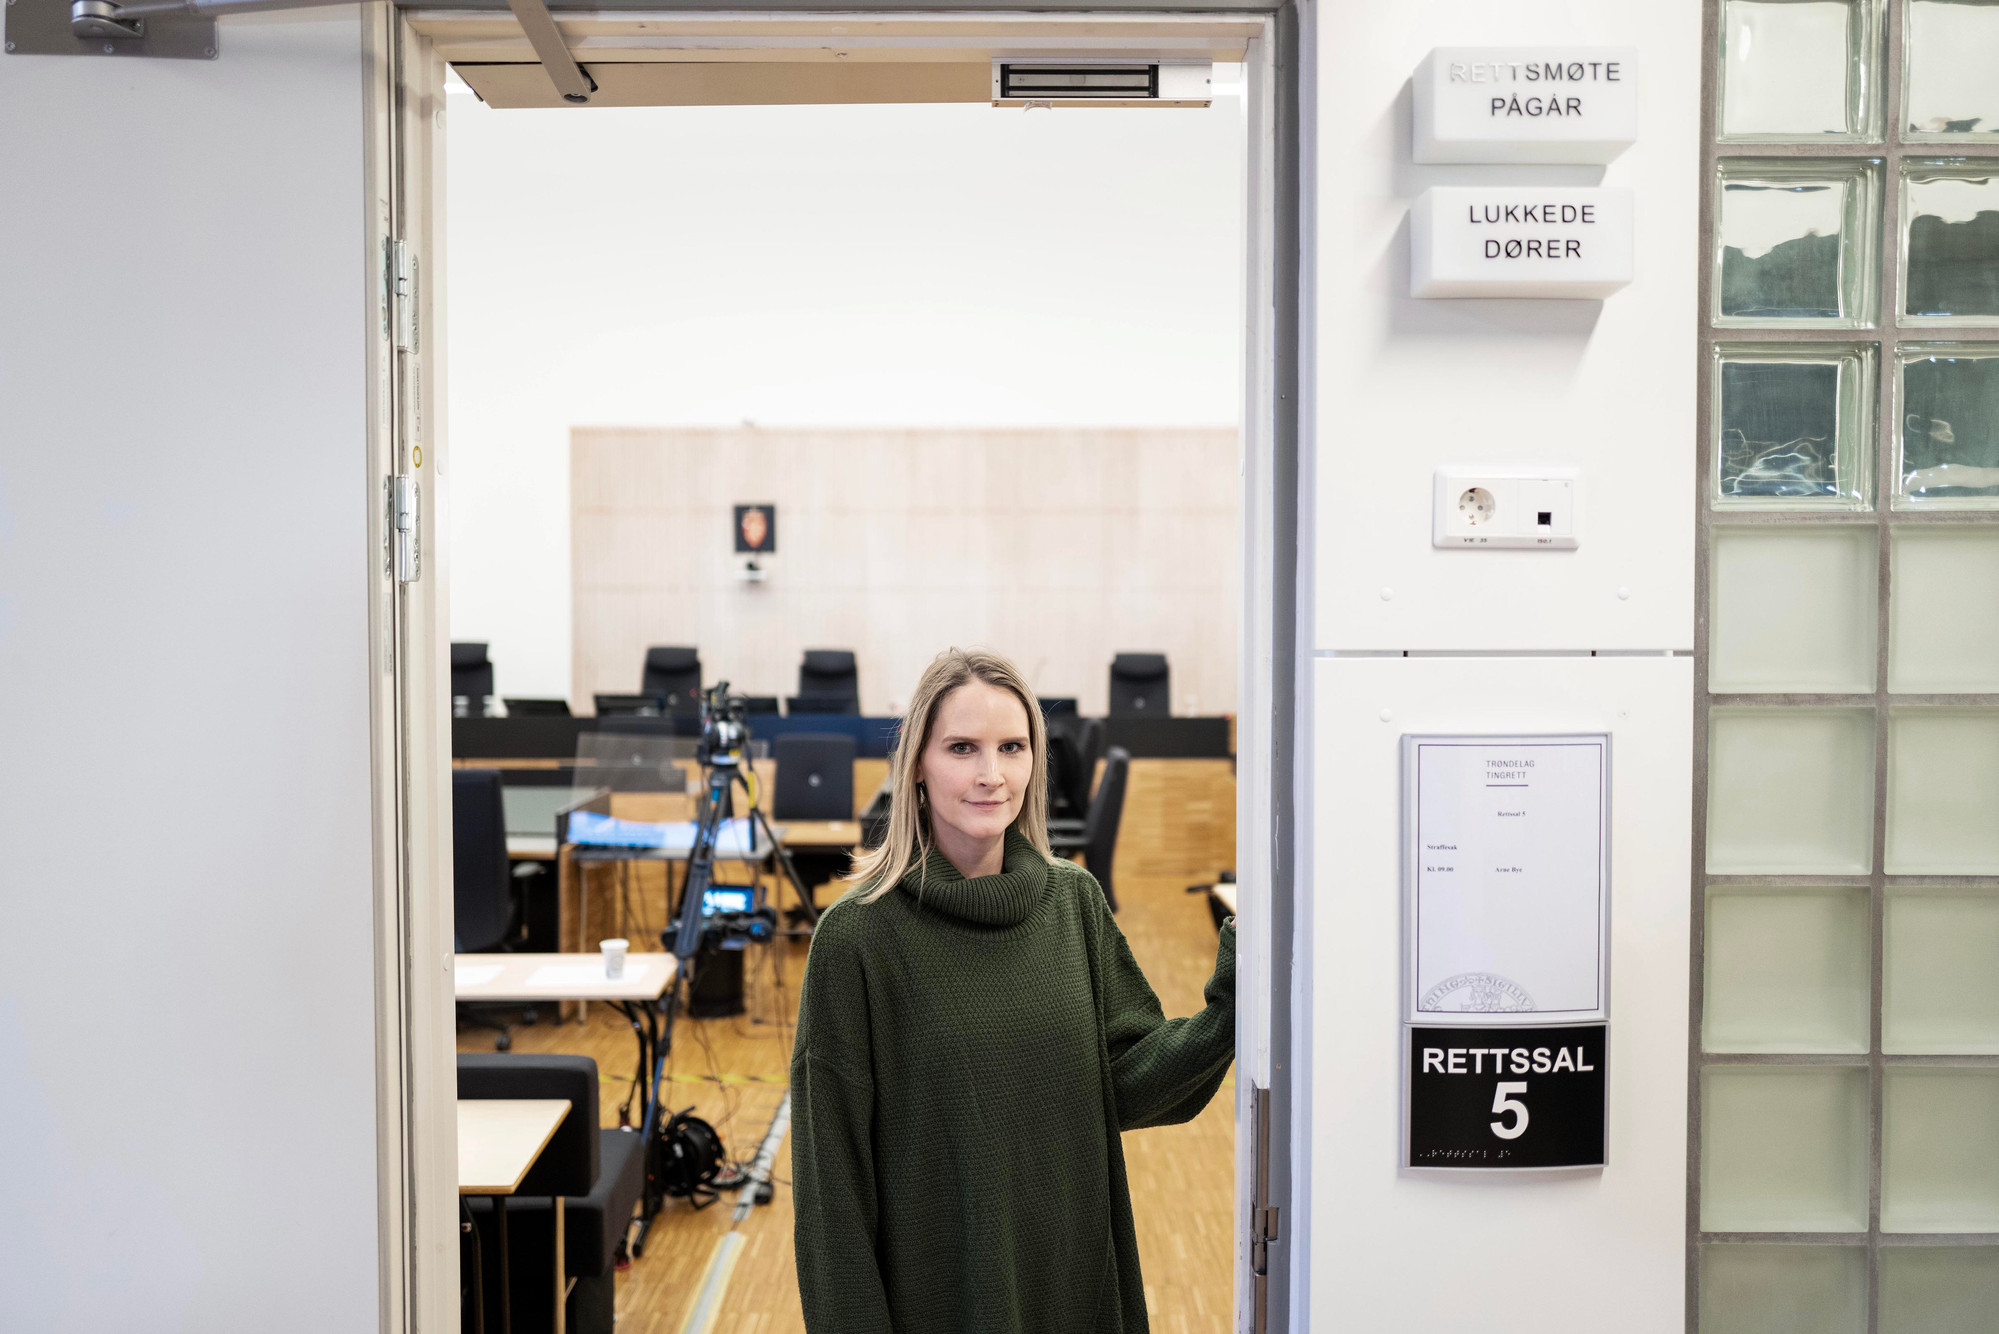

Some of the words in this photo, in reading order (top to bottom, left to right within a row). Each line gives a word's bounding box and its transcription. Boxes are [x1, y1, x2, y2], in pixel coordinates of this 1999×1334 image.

[1450, 62, 1621, 83] RETTSMØTE
[1469, 204, 1596, 224] LUKKEDE
[1484, 239, 1582, 259] DØRER
[1486, 760, 1535, 768] TRØNDELAG
[1486, 771, 1526, 779] TINGRETT
[1422, 1046, 1595, 1075] RETTSSAL
[1490, 1081, 1530, 1140] 5
